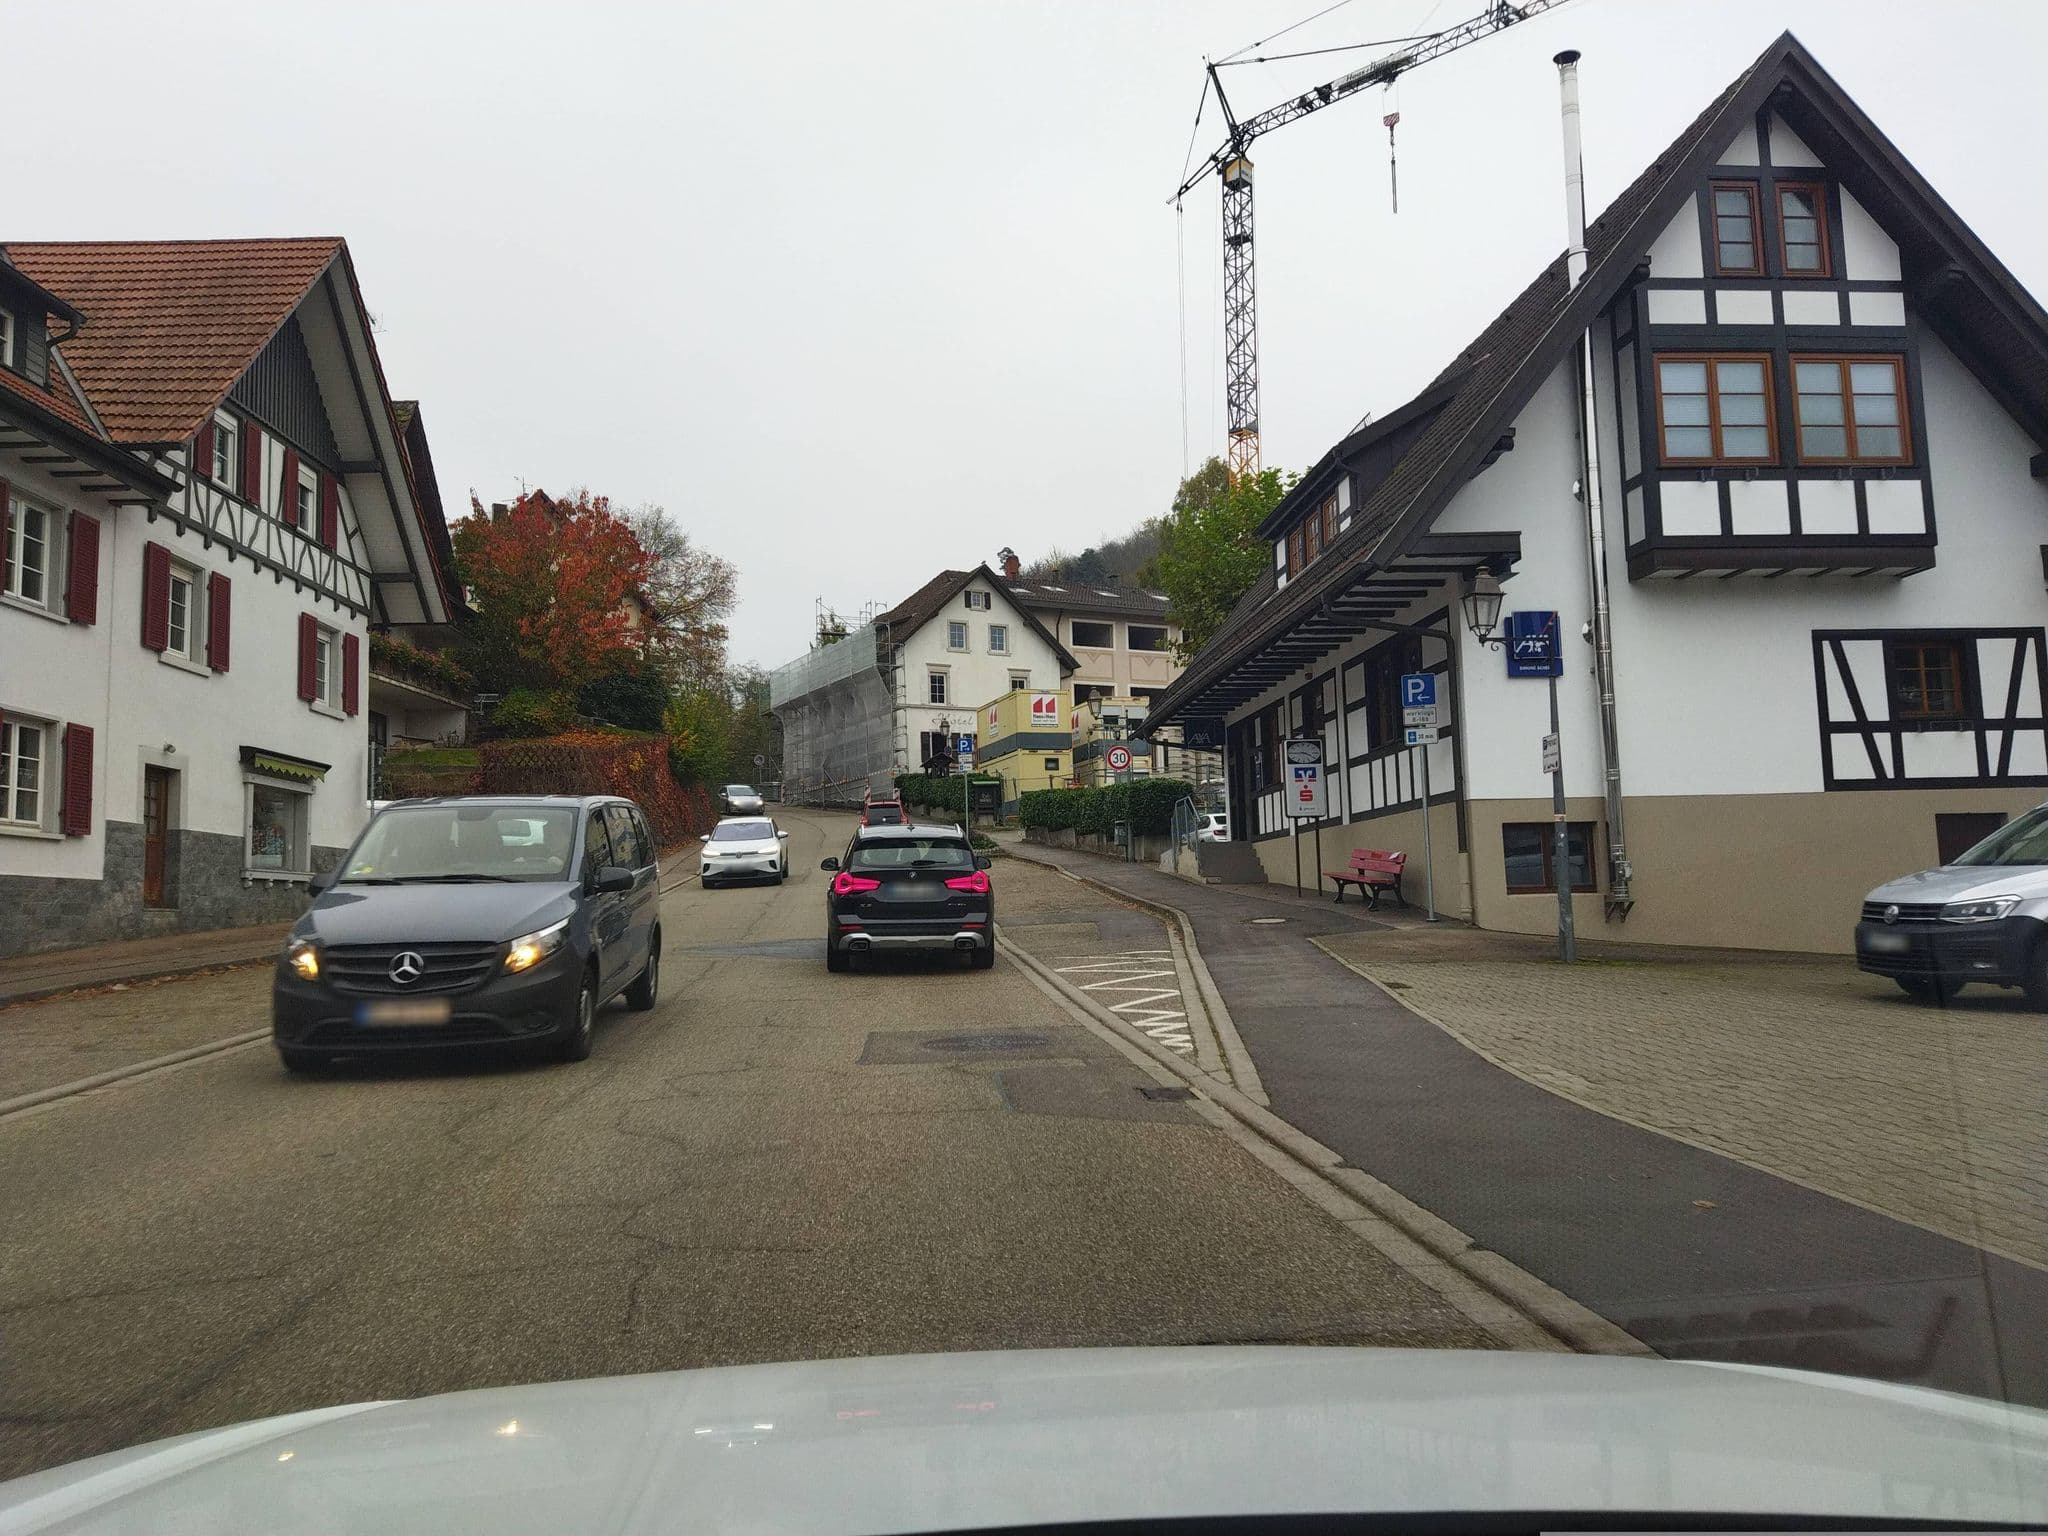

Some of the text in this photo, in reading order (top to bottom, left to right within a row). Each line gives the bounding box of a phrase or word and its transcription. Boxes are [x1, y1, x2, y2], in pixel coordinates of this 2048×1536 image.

[1407, 678, 1425, 703] P
[1187, 732, 1211, 745] AXA
[1112, 752, 1127, 764] 30
